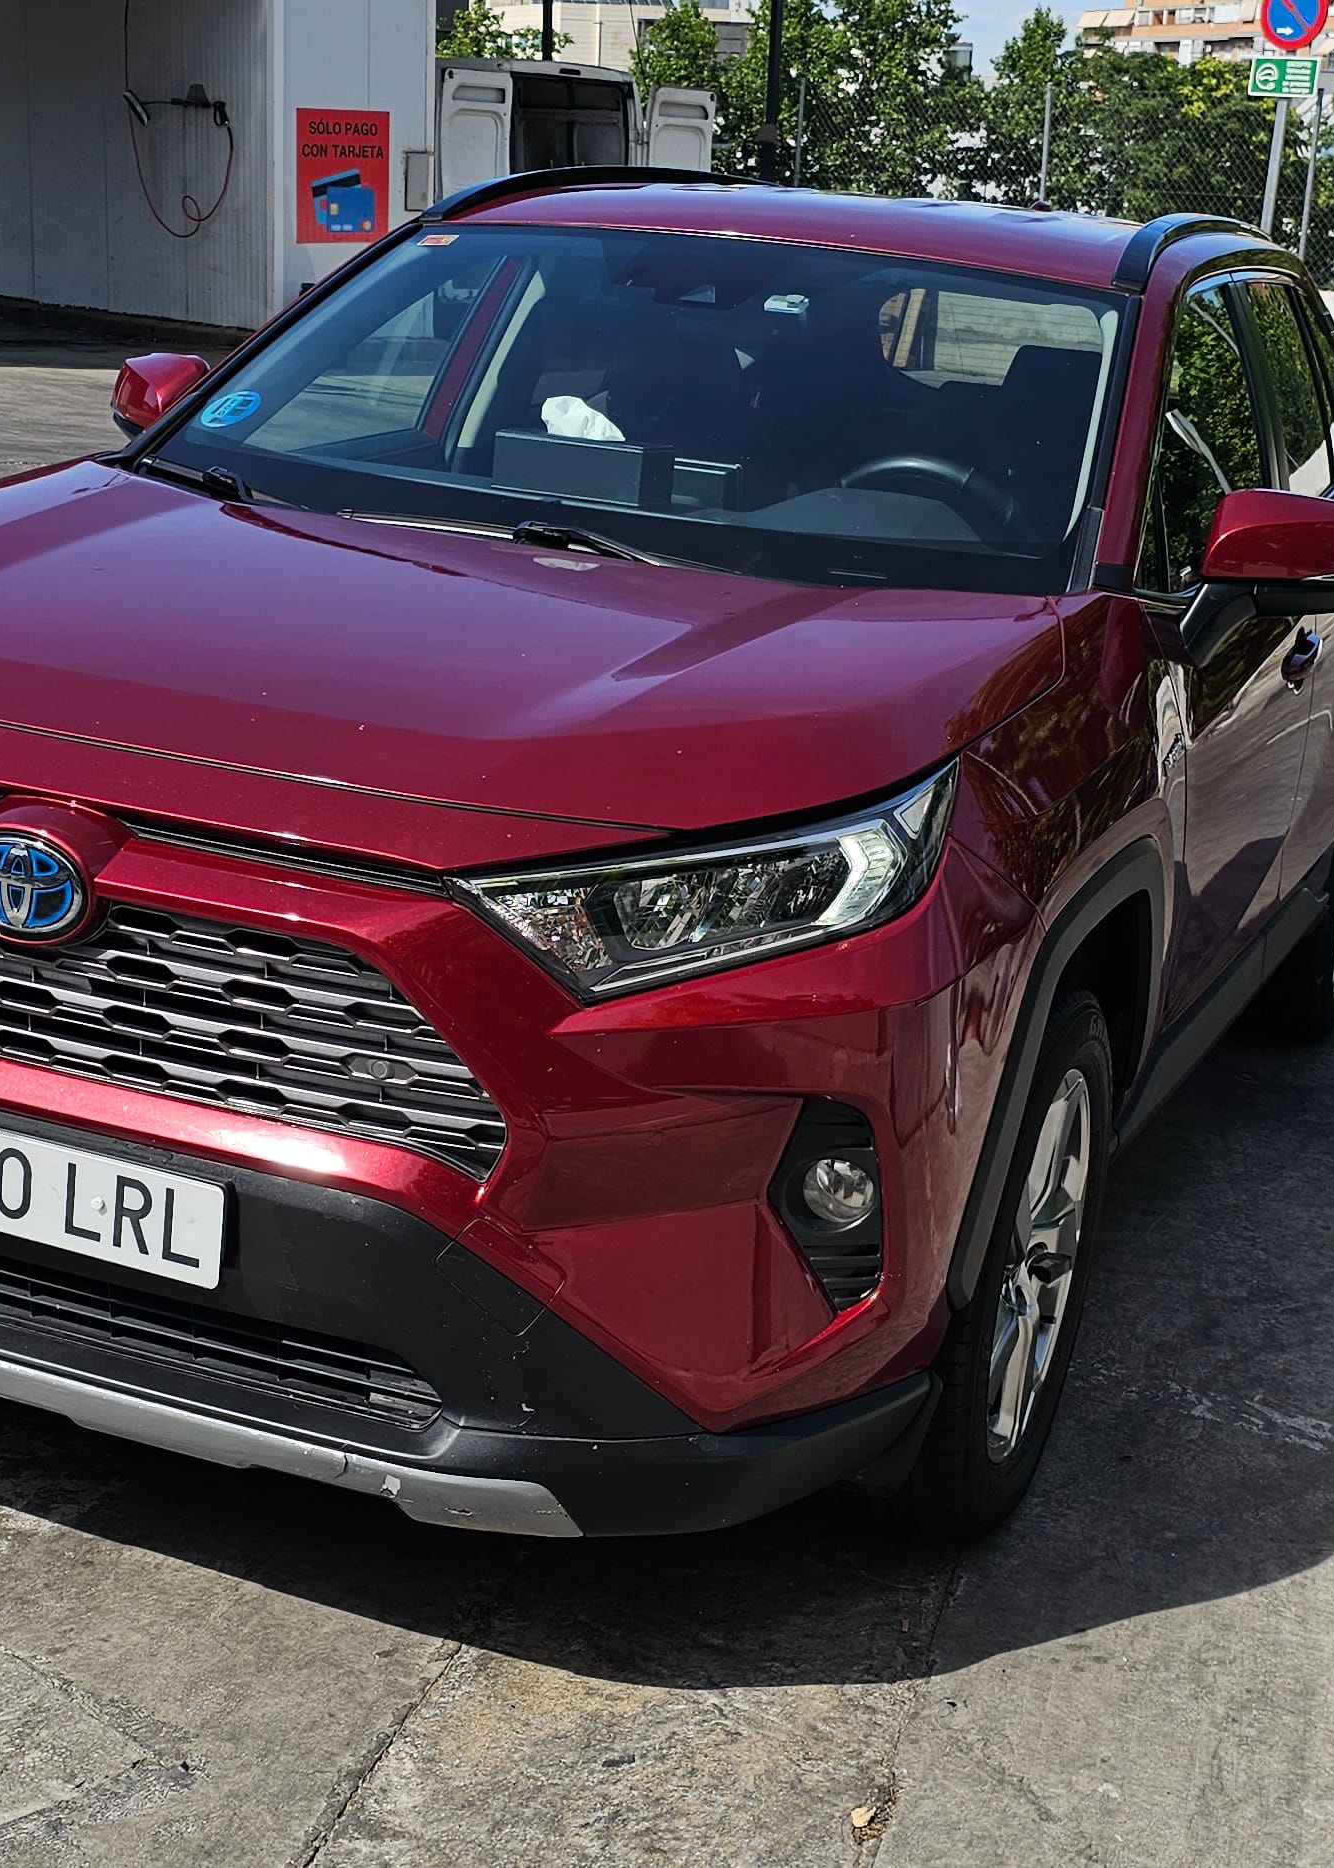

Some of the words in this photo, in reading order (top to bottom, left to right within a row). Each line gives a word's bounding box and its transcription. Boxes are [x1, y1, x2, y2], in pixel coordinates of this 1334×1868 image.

[308, 117, 342, 135] SÓLO
[344, 122, 378, 136] PAGO
[301, 143, 328, 158] CON
[332, 144, 384, 159] TARJETA
[64, 1162, 200, 1269] LRL
